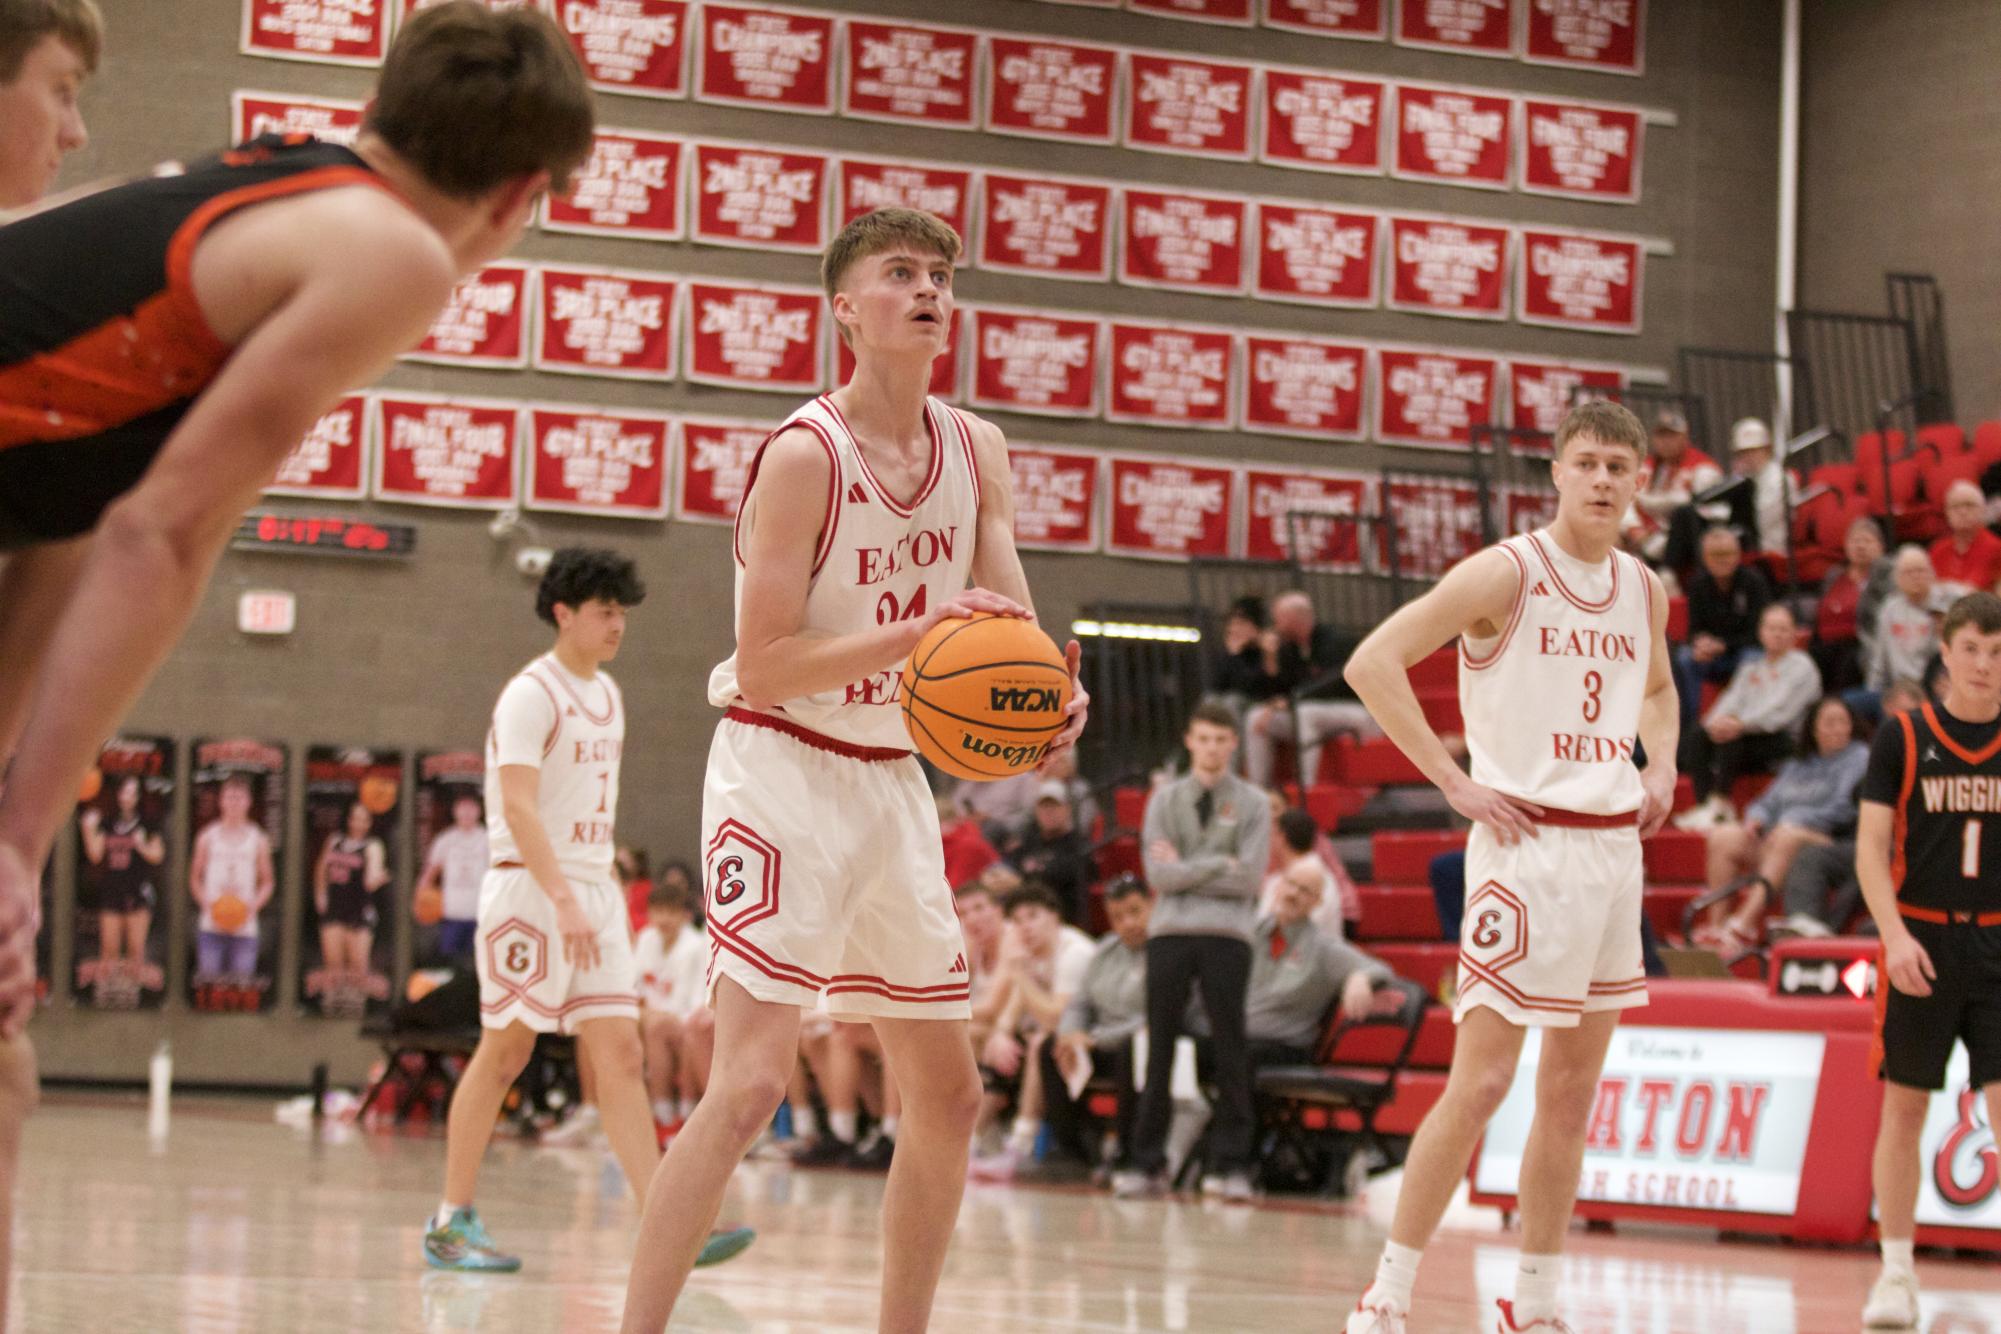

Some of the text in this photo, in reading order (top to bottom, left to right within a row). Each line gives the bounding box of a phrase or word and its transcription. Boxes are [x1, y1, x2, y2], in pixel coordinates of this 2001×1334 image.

[855, 526, 958, 586] EATON
[1538, 626, 1638, 663] EATON
[990, 687, 1061, 712] NCAA
[1582, 670, 1603, 724] 3
[1551, 733, 1635, 764] REDS
[595, 771, 609, 813] 1
[1961, 818, 1982, 880] 1
[1584, 1077, 1770, 1166] ATON
[1625, 1172, 1741, 1207] SCHOOL
